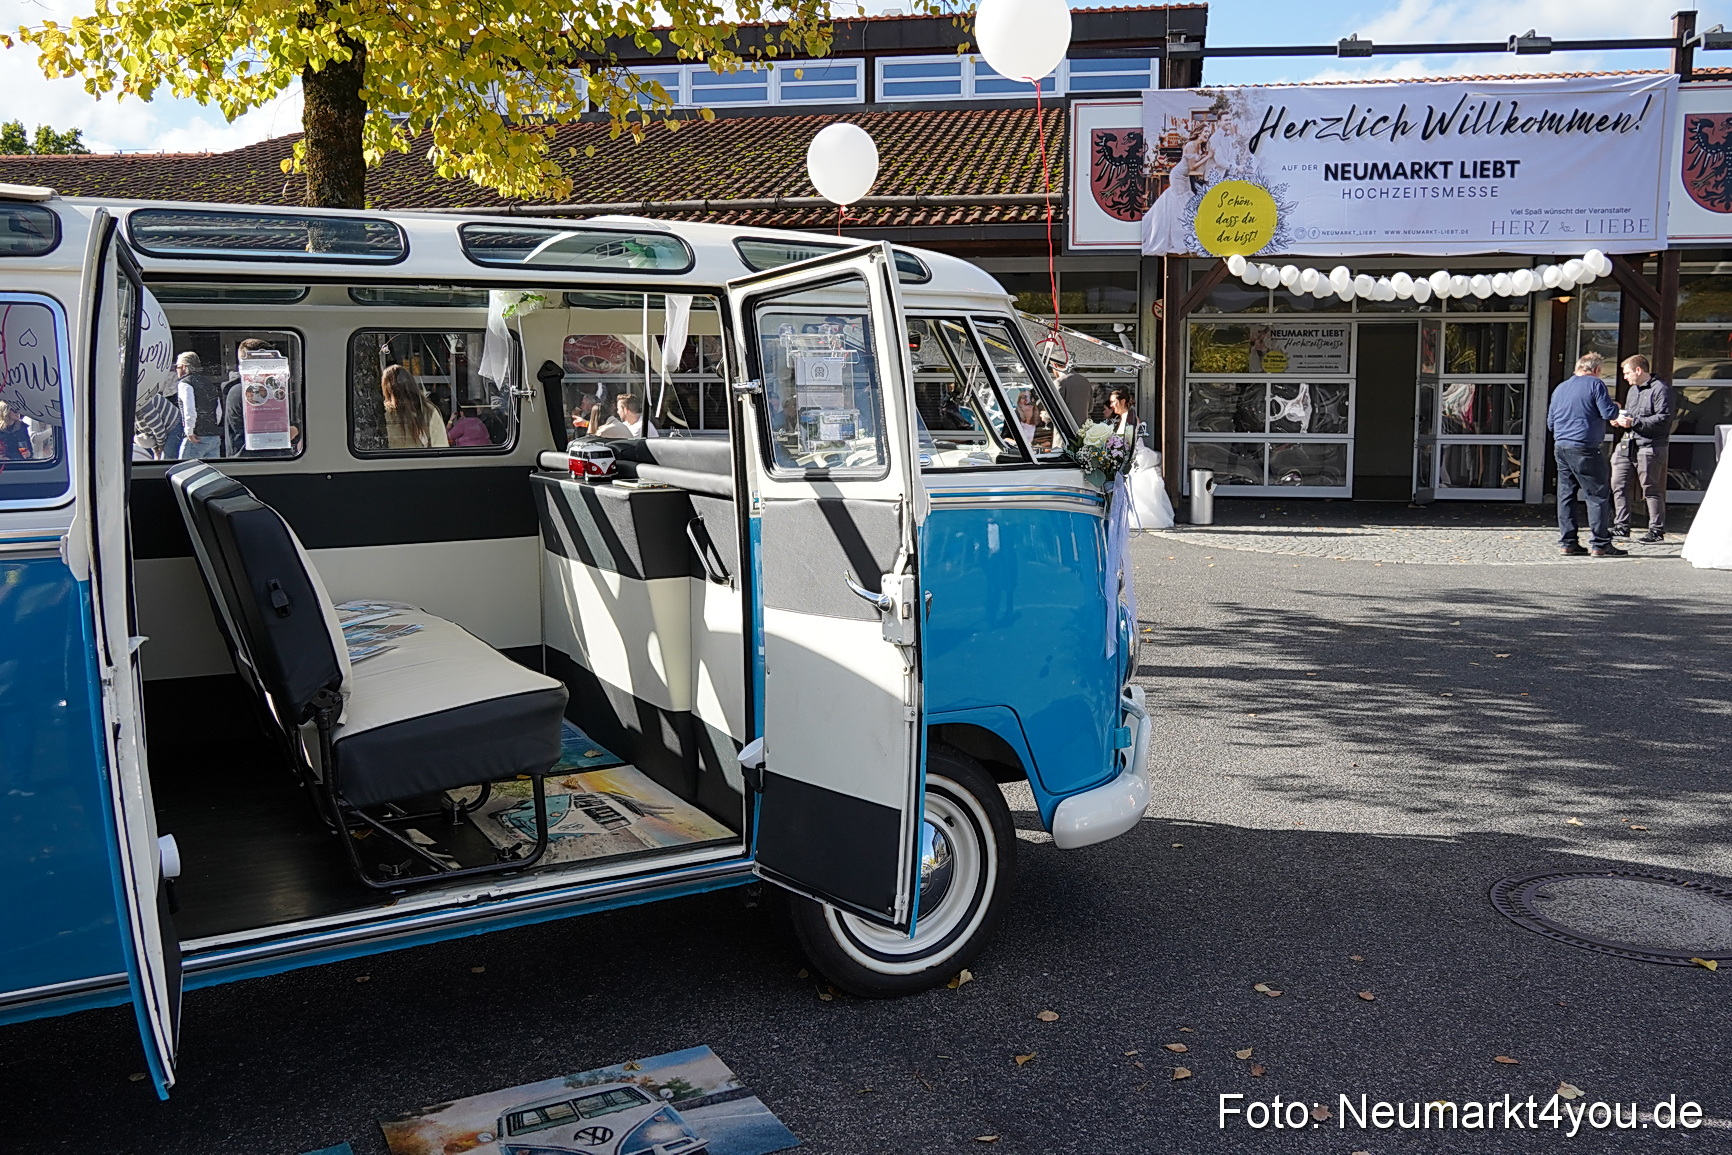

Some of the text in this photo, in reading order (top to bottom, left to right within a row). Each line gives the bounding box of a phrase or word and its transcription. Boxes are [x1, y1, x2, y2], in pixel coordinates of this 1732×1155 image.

[1249, 93, 1653, 154] Herzlich Willkommen!
[1281, 163, 1318, 172] AUF DER
[1323, 159, 1521, 181] NEUMARKT LIEBT
[1342, 186, 1499, 200] HOCHZEITSMESSE
[1241, 211, 1257, 225] du
[1510, 208, 1523, 216] Viel
[1524, 208, 1543, 216] Spaß
[1543, 207, 1573, 215] wünscht
[1574, 207, 1587, 215] der
[1491, 219, 1550, 235] HERZ
[1584, 218, 1650, 234] LIEBE
[1216, 229, 1233, 243] da
[1270, 329, 1345, 338] NEUMARKT LIEBT
[1284, 338, 1344, 350] Hochzeitsmesse
